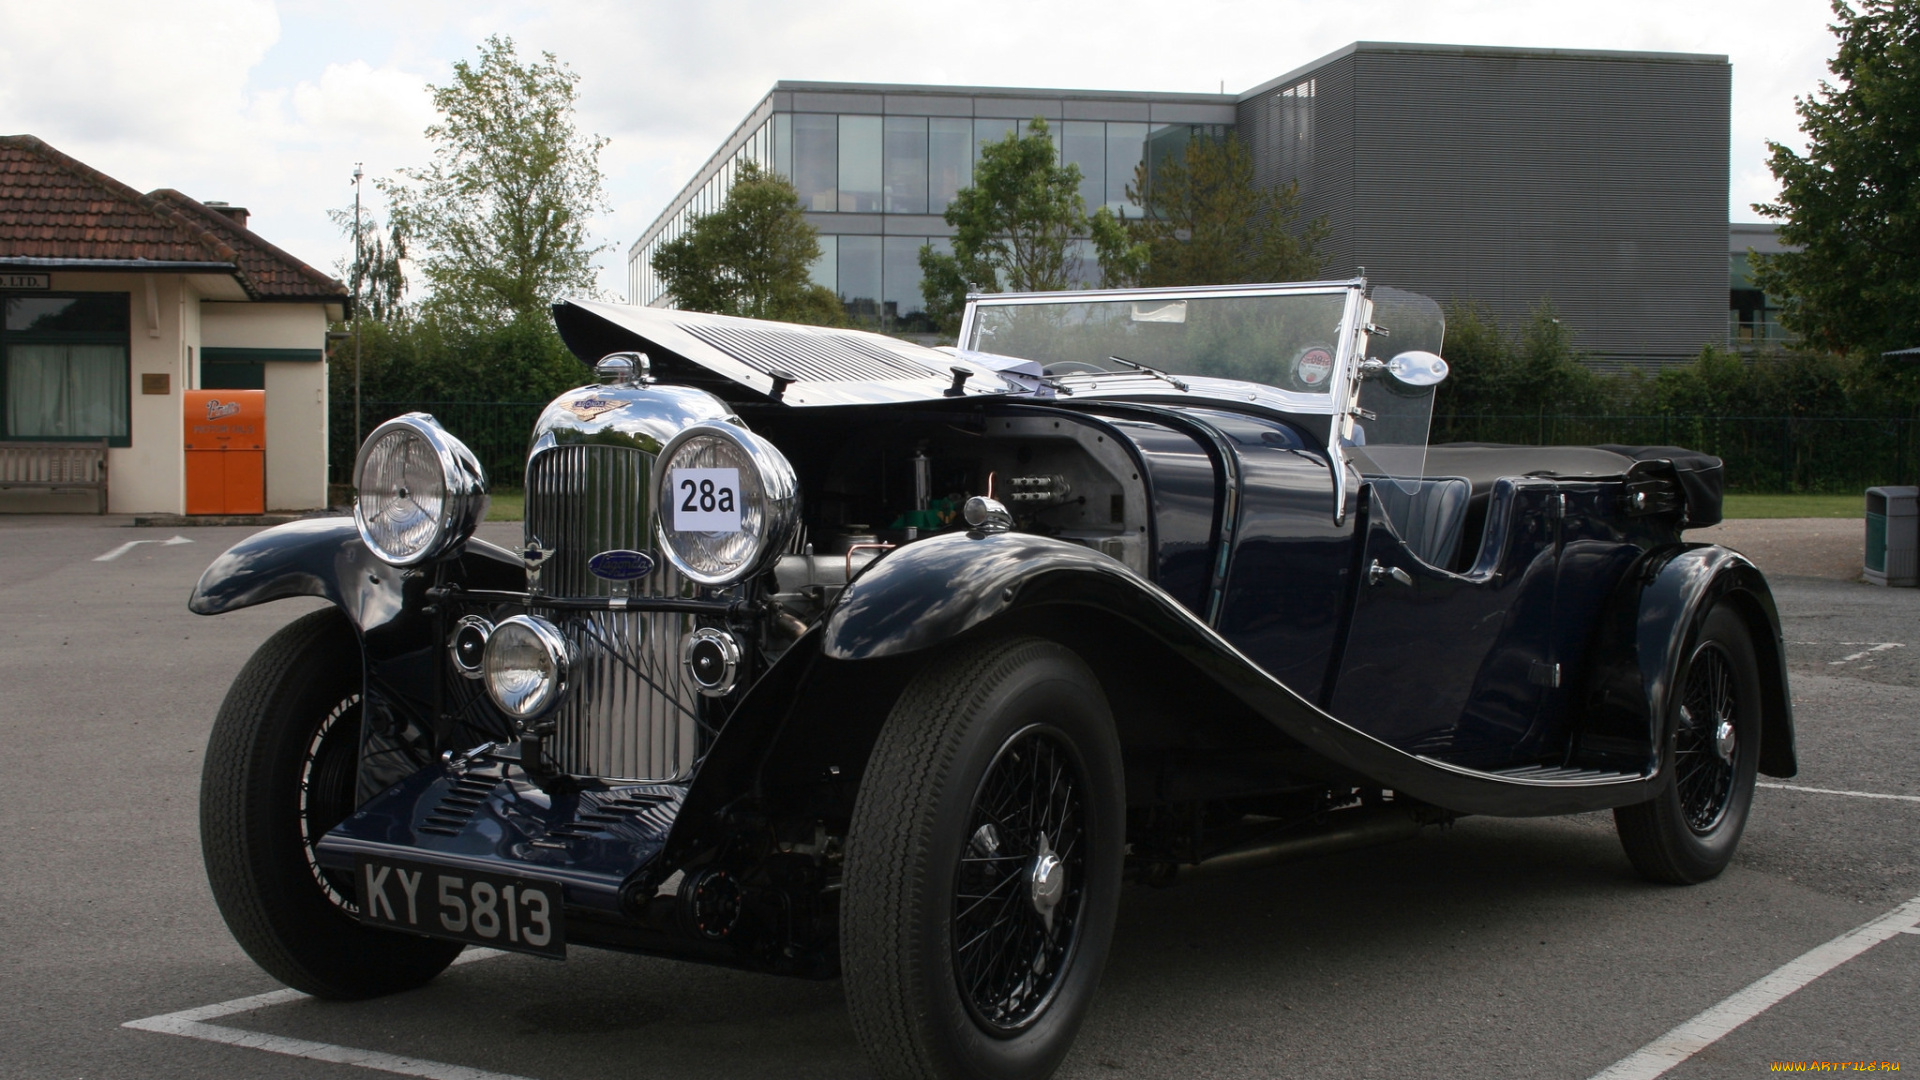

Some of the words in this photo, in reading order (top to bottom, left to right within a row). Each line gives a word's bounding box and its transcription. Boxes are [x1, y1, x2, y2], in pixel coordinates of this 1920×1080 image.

[10, 276, 40, 287] LTD.
[680, 478, 735, 512] 28a
[365, 863, 422, 924] KY
[438, 874, 551, 946] 5813
